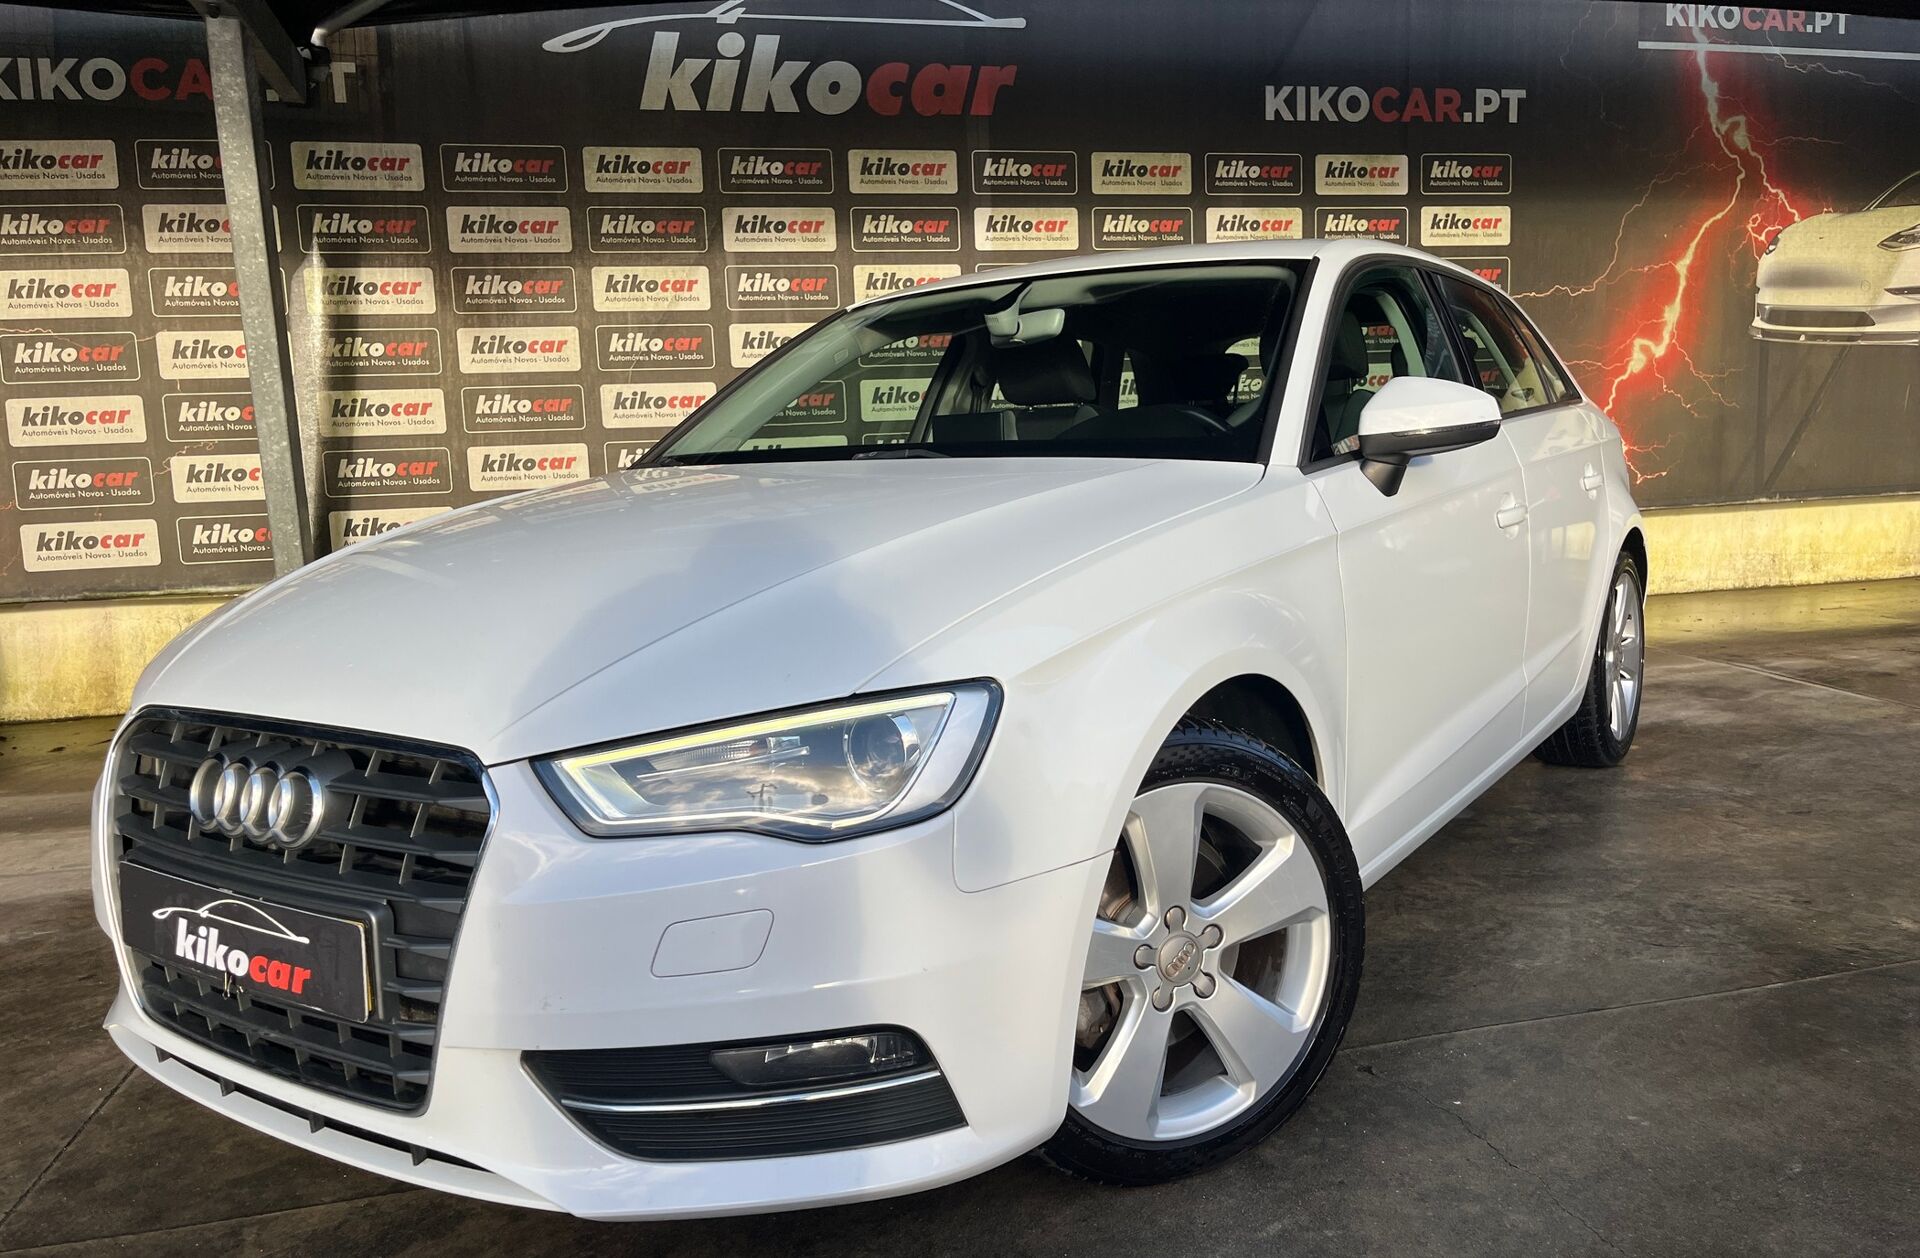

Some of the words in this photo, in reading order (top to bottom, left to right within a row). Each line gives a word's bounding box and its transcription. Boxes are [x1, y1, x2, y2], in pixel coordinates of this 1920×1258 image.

[1666, 4, 1850, 35] KIKOCAR.PT
[640, 31, 1017, 117] kikocar
[1265, 85, 1526, 123] KIKOCAR.PT
[151, 149, 222, 169] kiko
[306, 150, 410, 171] kikocar
[455, 153, 554, 173] kikocar
[596, 155, 690, 174] kikocar
[731, 156, 821, 175] kikocar
[860, 158, 946, 176] kikocar
[983, 158, 1066, 176] kikocar
[1102, 160, 1182, 177] kikocar
[1215, 161, 1292, 178] kikocar
[1325, 162, 1399, 178] kikocar
[1430, 161, 1502, 177] kikocar
[0, 214, 110, 234] kikocar
[158, 213, 230, 233] kikoc
[312, 213, 416, 233] kikocar
[461, 215, 559, 234] kikocar
[600, 215, 694, 233] kikocar
[735, 216, 824, 233] kikocar
[863, 215, 949, 233] kikocar
[985, 216, 1068, 232] kikocar
[1103, 215, 1182, 232] kikocar
[1216, 216, 1293, 231] kikocar
[1325, 215, 1399, 231] kikocar
[1430, 214, 1502, 229] kikocar
[83, 235, 112, 243] Usados
[8, 279, 116, 299] kikocar
[165, 276, 239, 296] kikoc
[319, 277, 421, 295] kikocar
[465, 275, 563, 294] kikocar
[605, 275, 698, 293] kikocar
[738, 273, 827, 291] kikocar
[539, 295, 564, 303] Usados
[172, 340, 247, 359] kikoc
[325, 338, 427, 357] kikocar
[471, 336, 568, 354] kikocar
[609, 333, 702, 351] kikocar
[14, 342, 123, 363] kikocar
[97, 363, 126, 371] Usados
[476, 395, 572, 413] kikocar
[614, 392, 706, 409] kikocar
[872, 386, 926, 404] kiko
[22, 406, 130, 427] kikocar
[179, 402, 254, 421] kikoc
[332, 399, 432, 418] kikocar
[548, 413, 573, 421] Usados
[104, 426, 133, 434] Usados
[338, 458, 438, 477] kikocar
[481, 454, 577, 472] kikocar
[29, 468, 138, 489] kikocar
[186, 464, 261, 483] kikoc
[111, 488, 141, 496] Usados
[36, 531, 145, 552] kikocar
[193, 524, 272, 544] kikoc
[176, 917, 311, 994] kikocar
